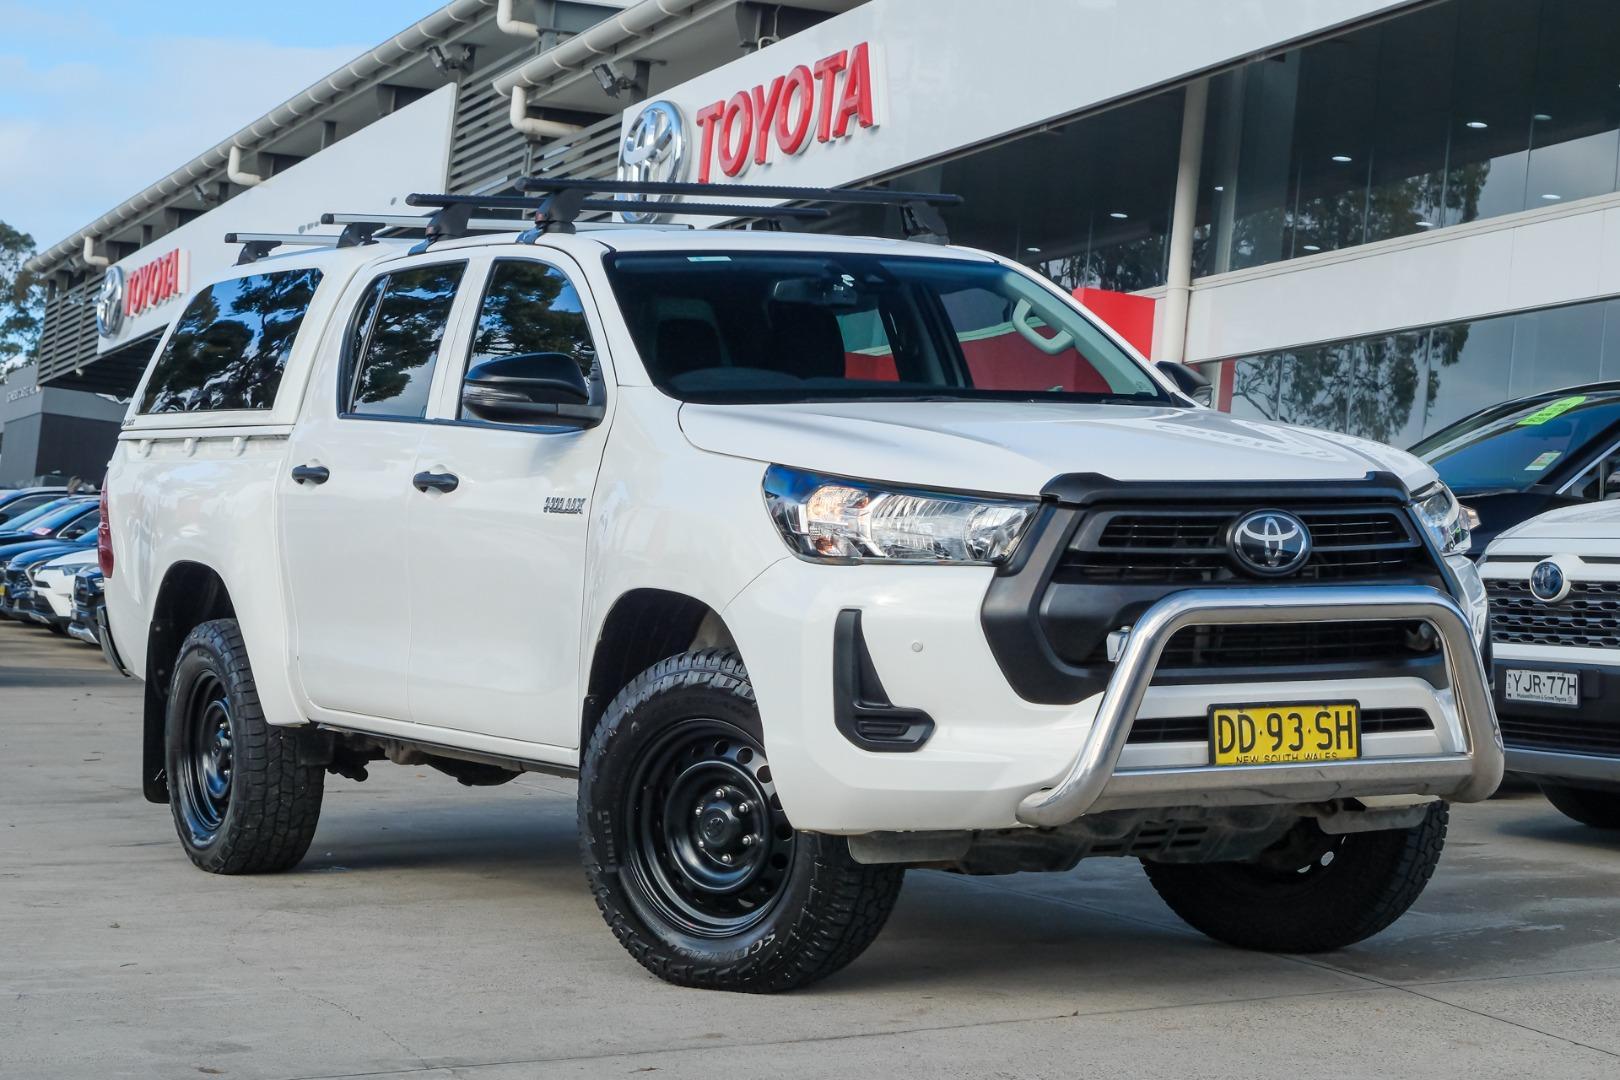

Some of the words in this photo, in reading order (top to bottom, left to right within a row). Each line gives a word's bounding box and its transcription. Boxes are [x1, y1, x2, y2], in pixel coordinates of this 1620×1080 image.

[697, 41, 873, 184] TOYOTA
[124, 248, 180, 317] TOYOTA
[543, 496, 587, 514] HILUX
[1236, 755, 1259, 764] NEW
